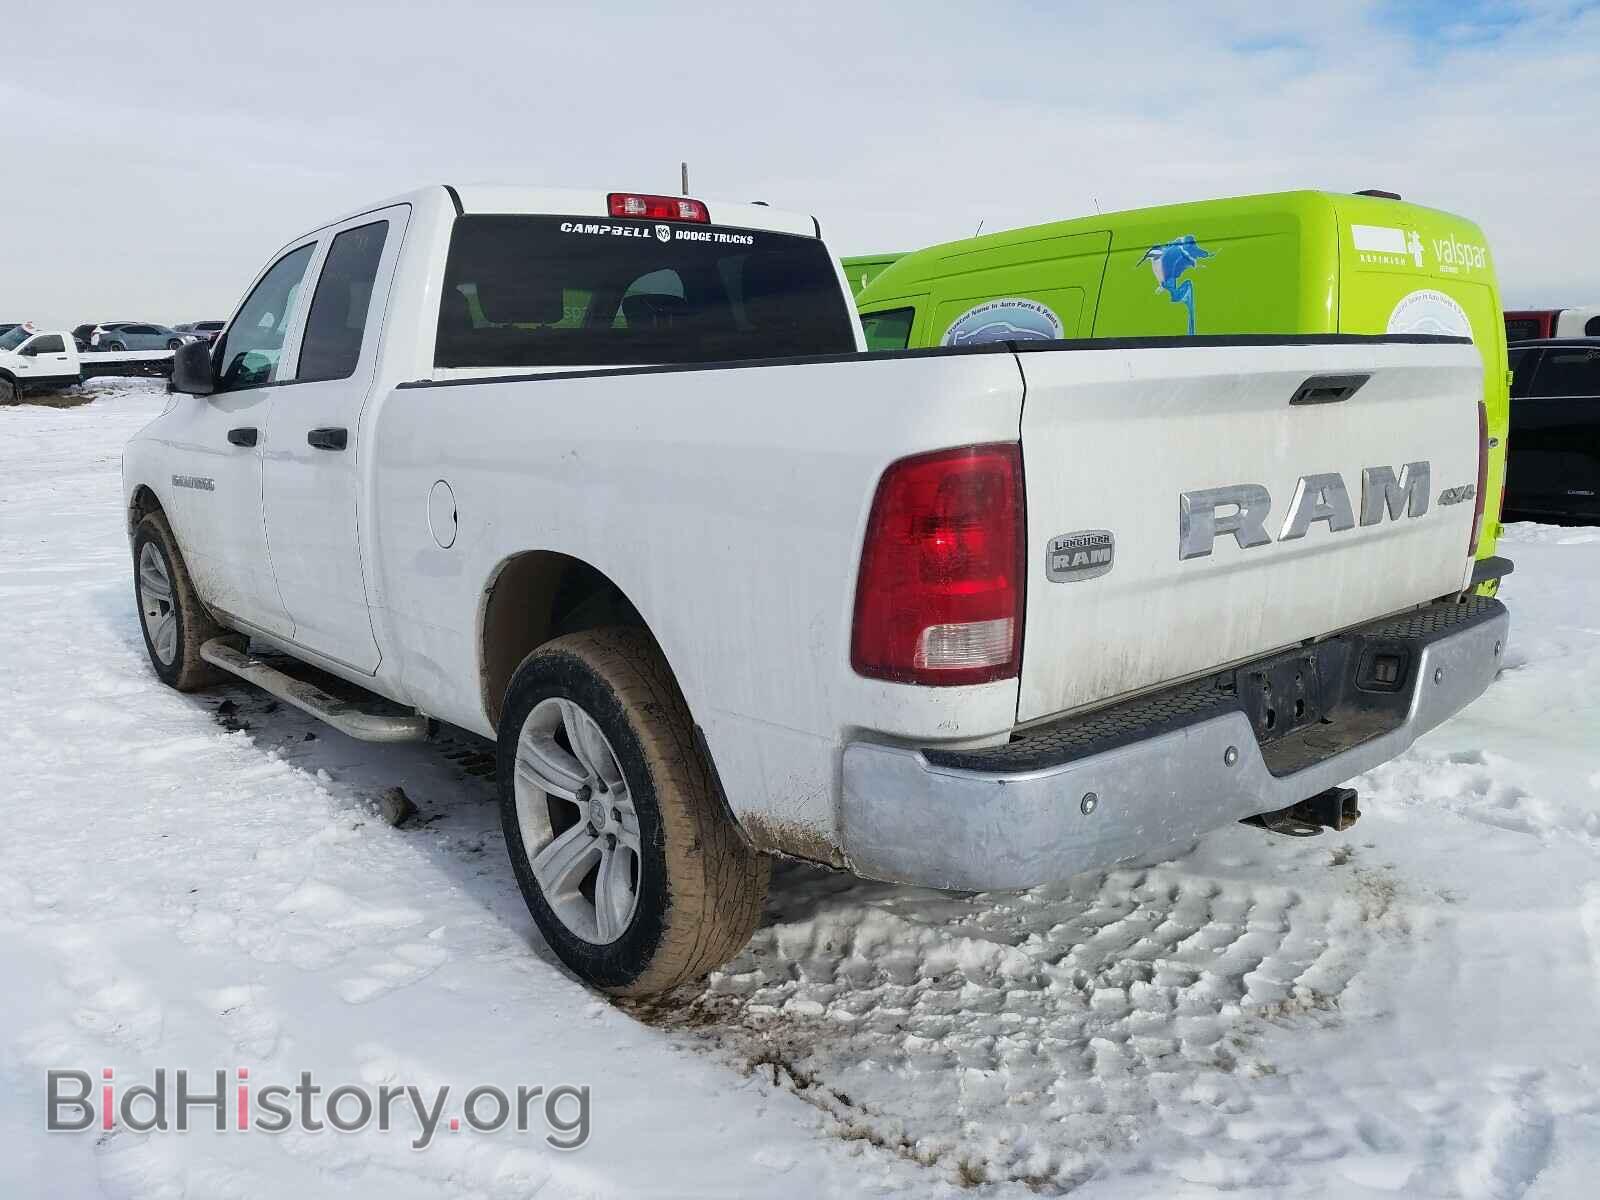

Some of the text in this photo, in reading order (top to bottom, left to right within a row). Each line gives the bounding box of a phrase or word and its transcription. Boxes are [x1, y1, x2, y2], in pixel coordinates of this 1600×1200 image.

[560, 222, 652, 238] CAMPBELL
[675, 230, 754, 245] DODGE TRUCKS
[1432, 232, 1486, 272] valspar
[1178, 460, 1431, 561] RAM
[1053, 548, 1110, 569] RAM
